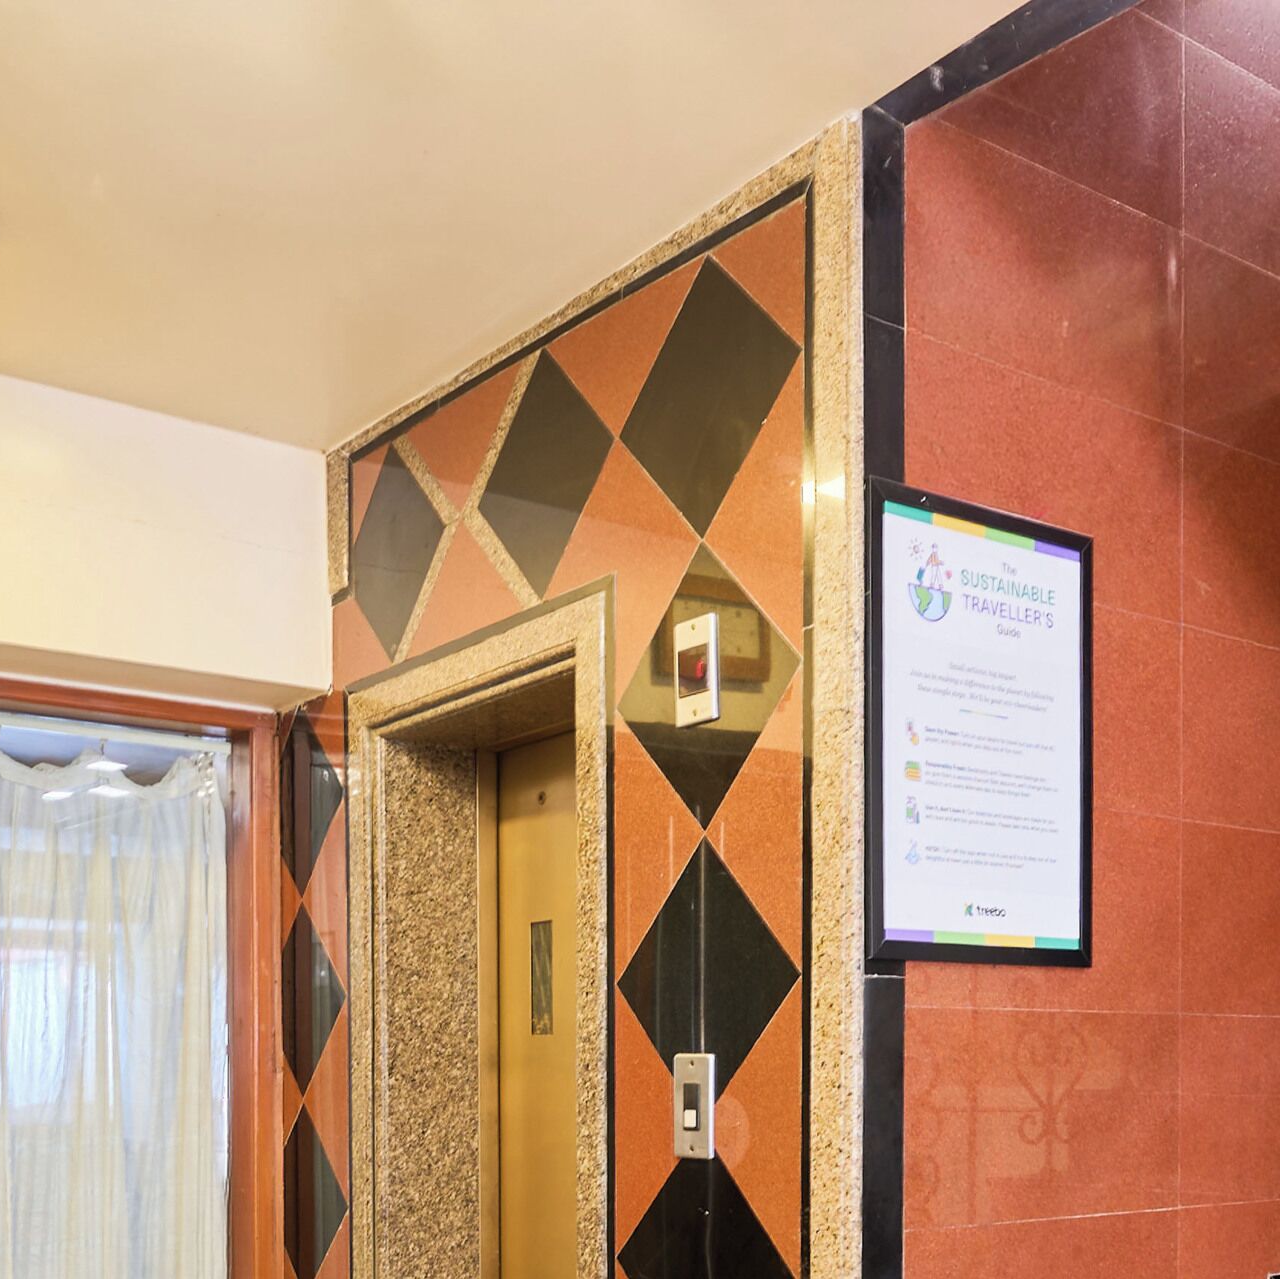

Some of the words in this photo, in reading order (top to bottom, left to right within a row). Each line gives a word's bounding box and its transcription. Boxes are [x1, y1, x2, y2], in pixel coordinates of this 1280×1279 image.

[1003, 562, 1018, 577] The
[961, 568, 1056, 606] SUSTAINABLE
[963, 593, 1054, 629] TRAVELLER'S
[997, 623, 1022, 639] Guide
